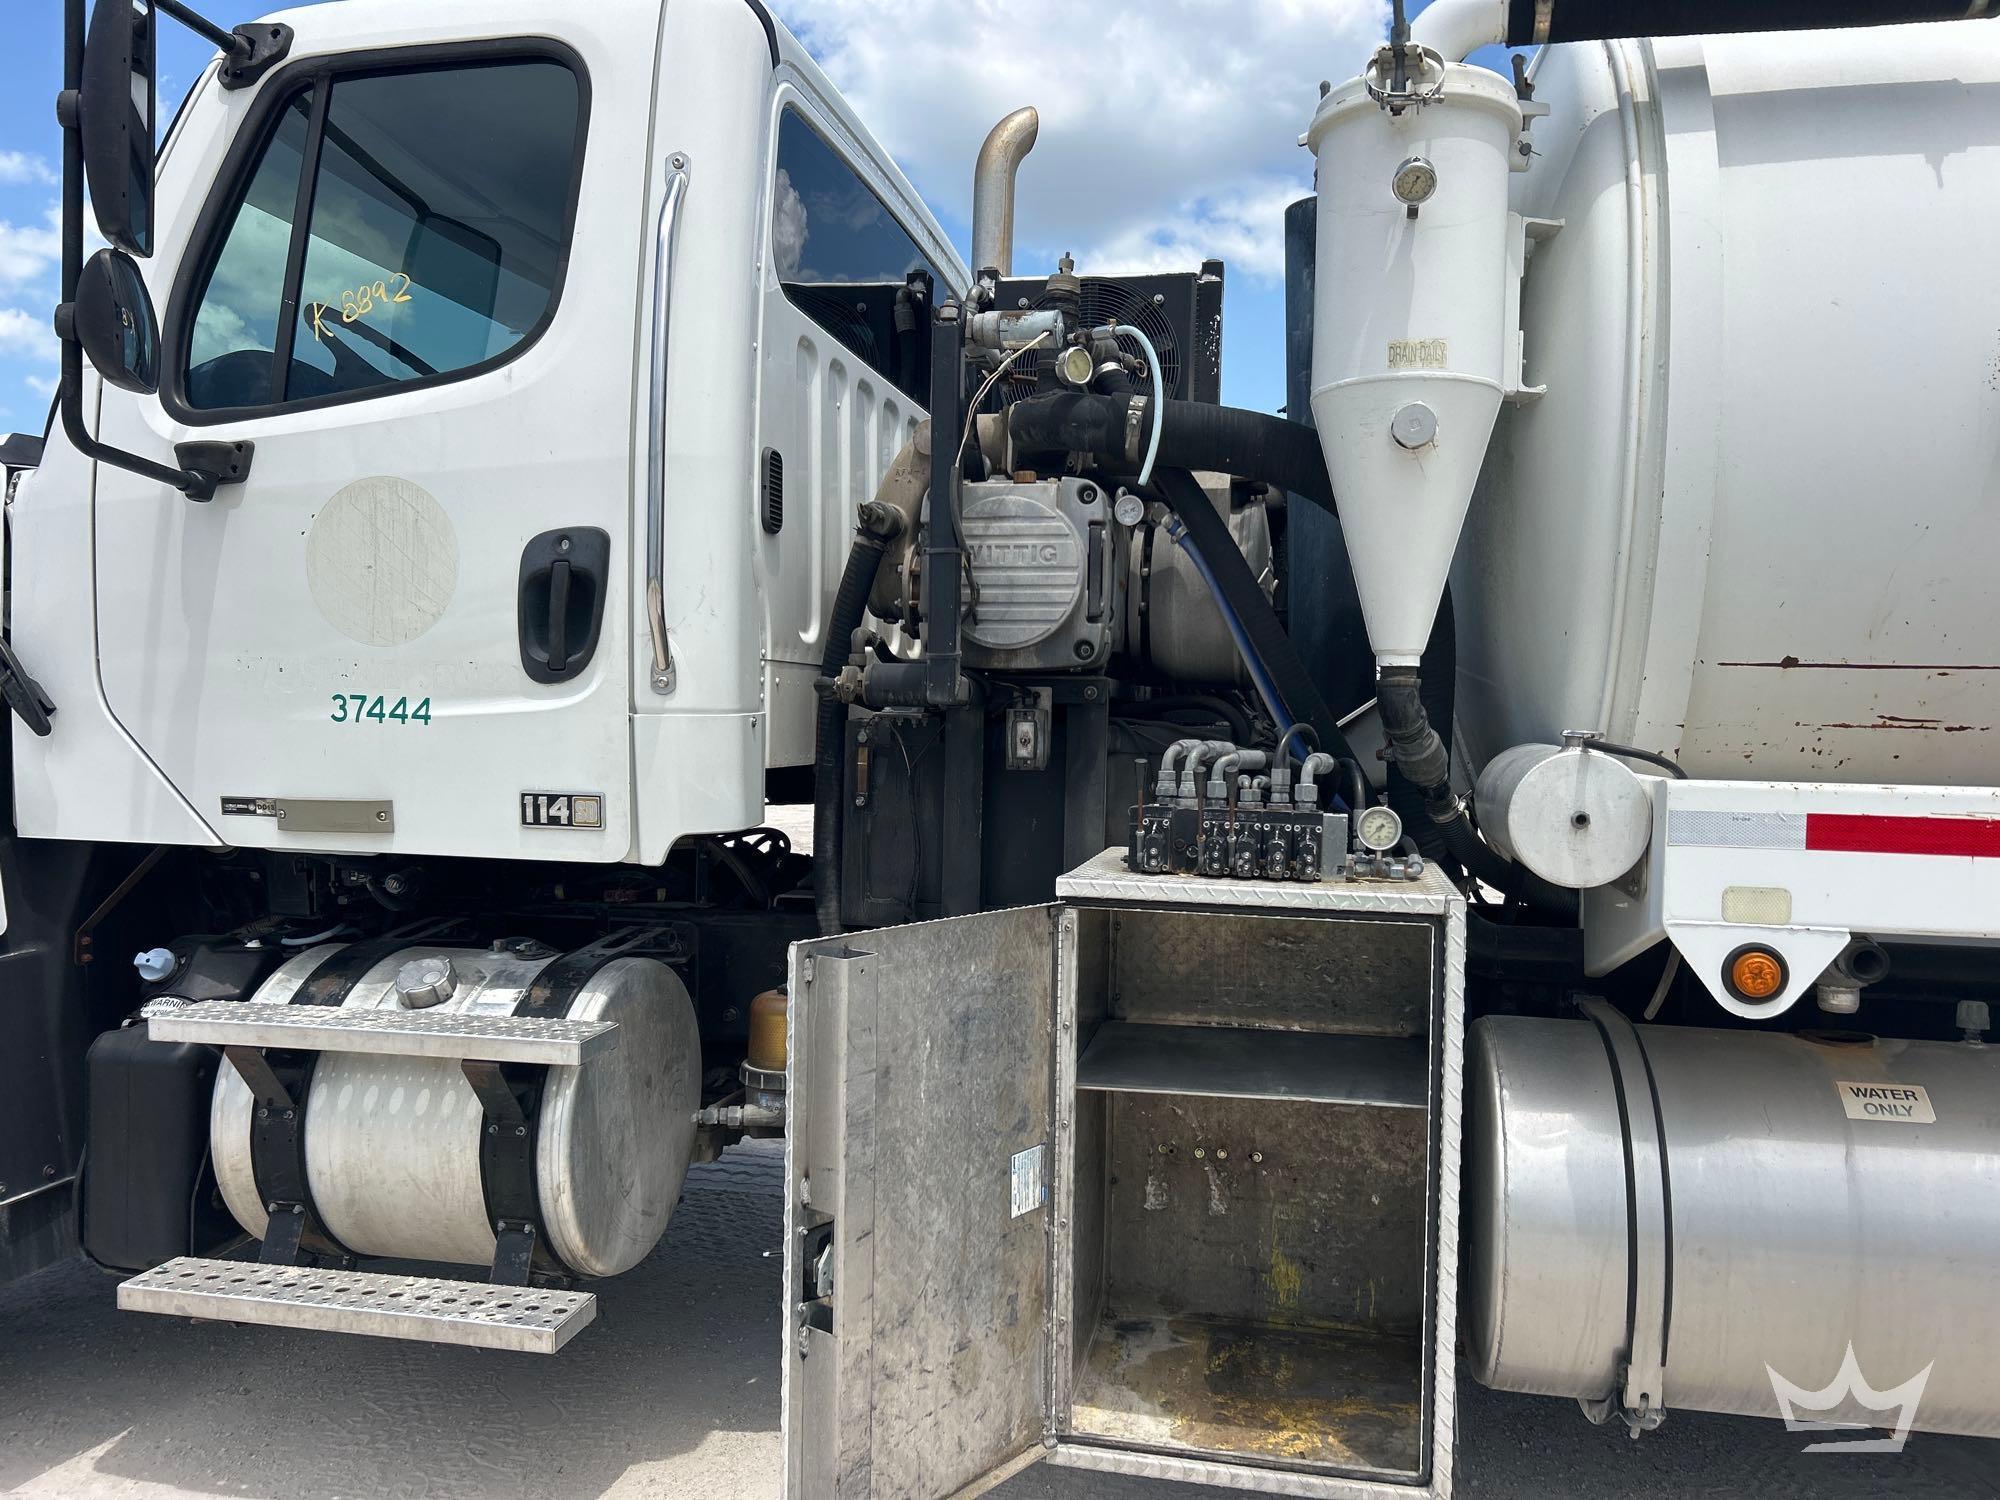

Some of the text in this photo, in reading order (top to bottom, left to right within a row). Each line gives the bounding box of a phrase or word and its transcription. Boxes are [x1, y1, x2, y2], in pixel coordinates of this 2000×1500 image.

[313, 272, 413, 342] K 8892
[1388, 342, 1447, 363] DRAIN DAILY
[330, 693, 432, 726] 37444
[523, 795, 570, 824] 114
[1849, 1086, 1918, 1101] WATER
[1863, 1102, 1913, 1117] ONLY
